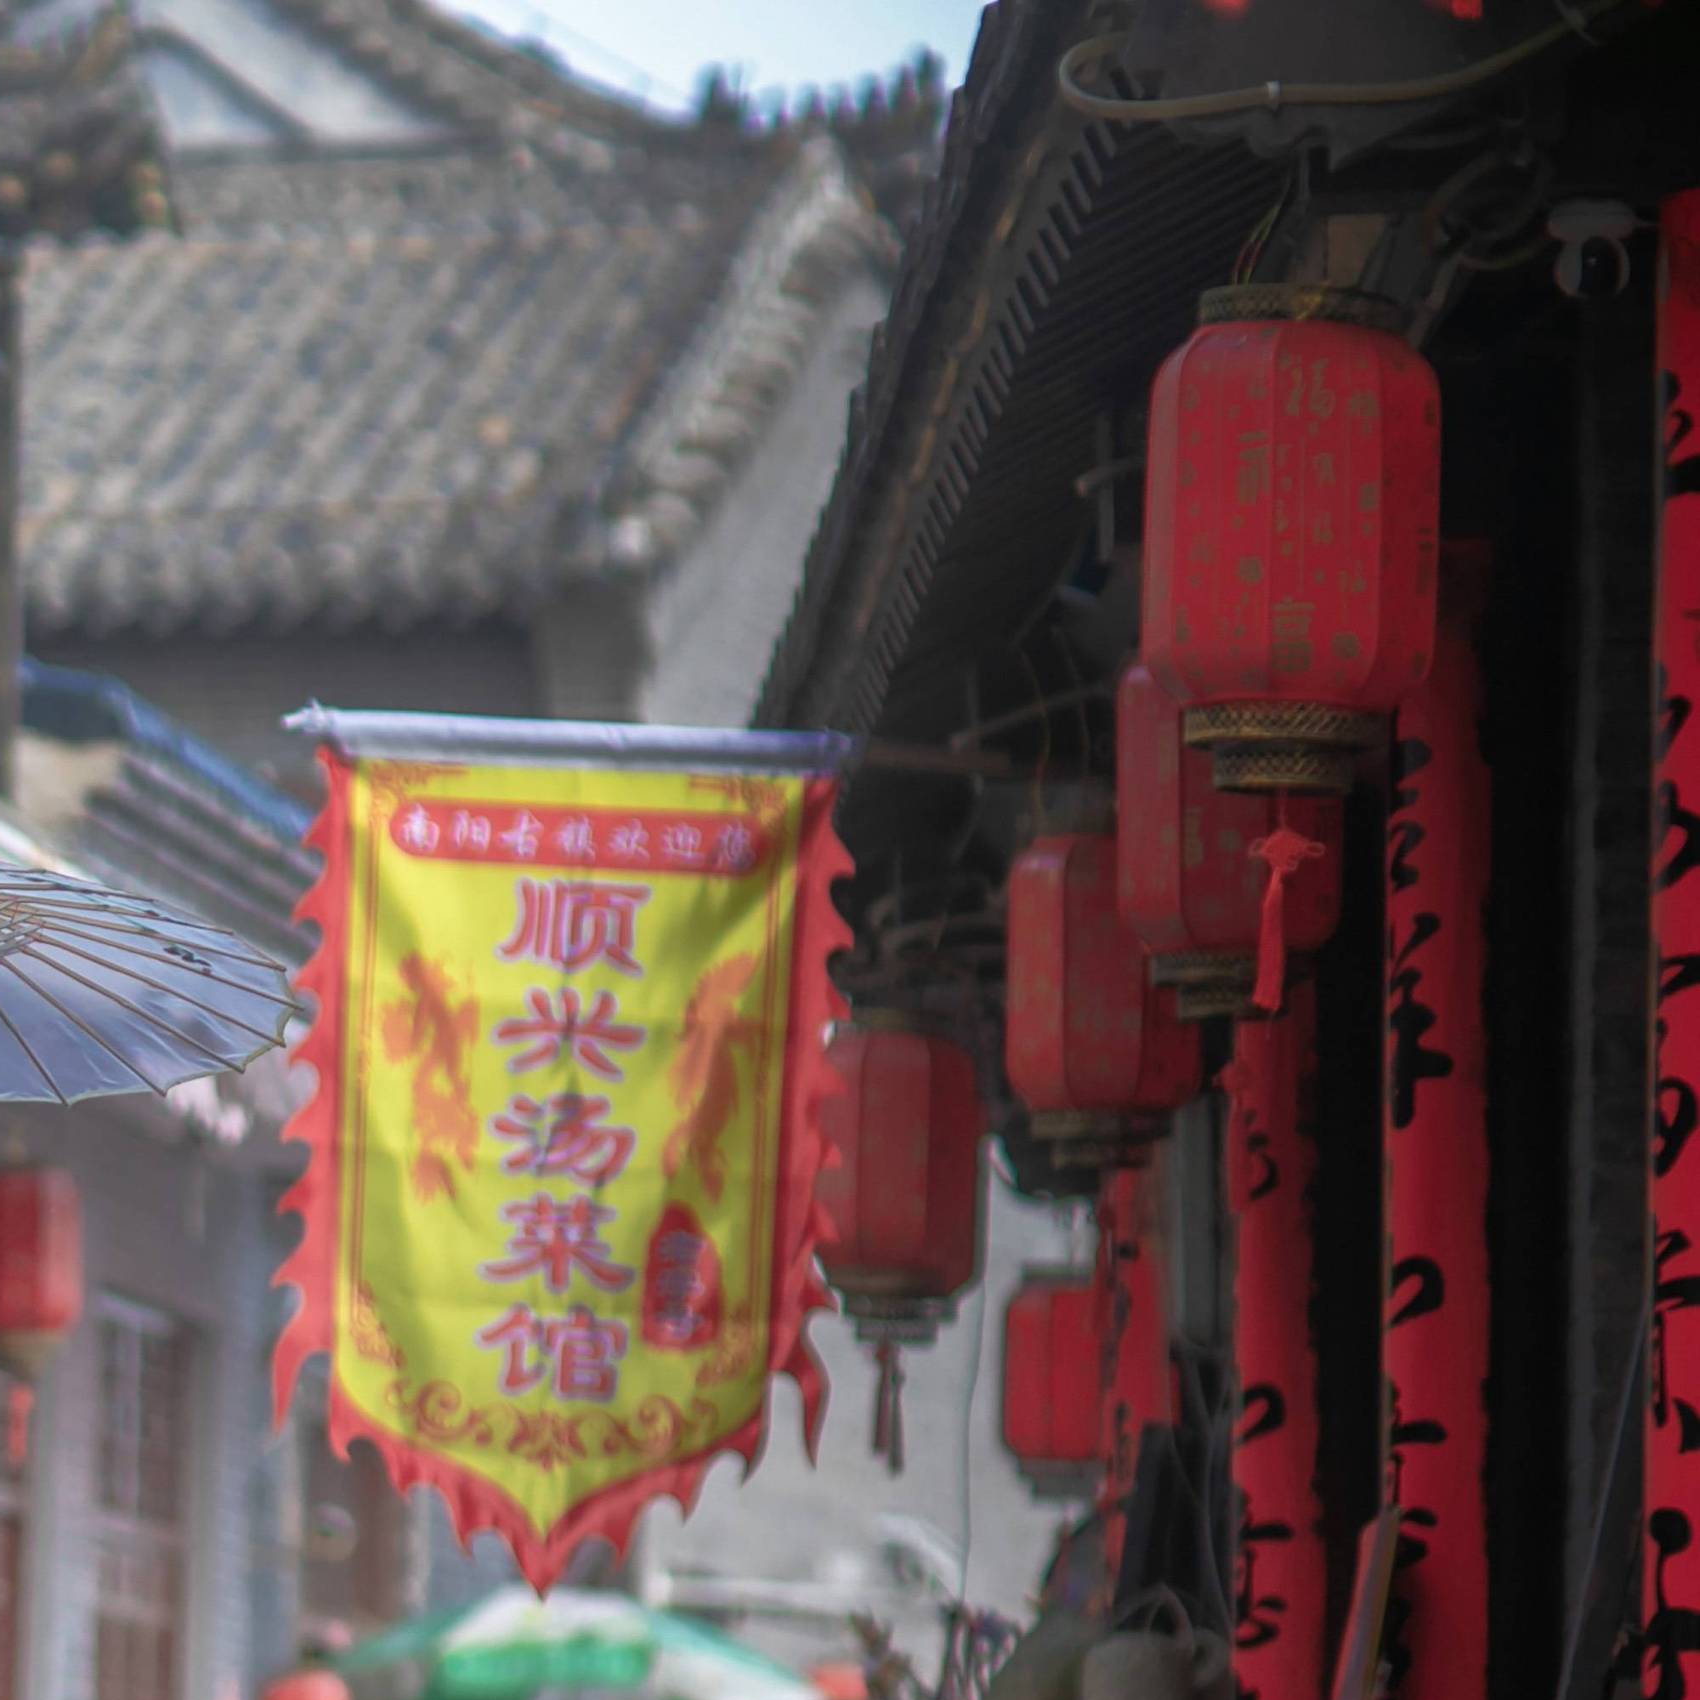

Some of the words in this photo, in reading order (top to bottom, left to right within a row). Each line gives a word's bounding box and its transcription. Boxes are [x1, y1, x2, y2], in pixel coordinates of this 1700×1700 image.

[477, 878, 652, 1404] 顺兴汤菜馆
